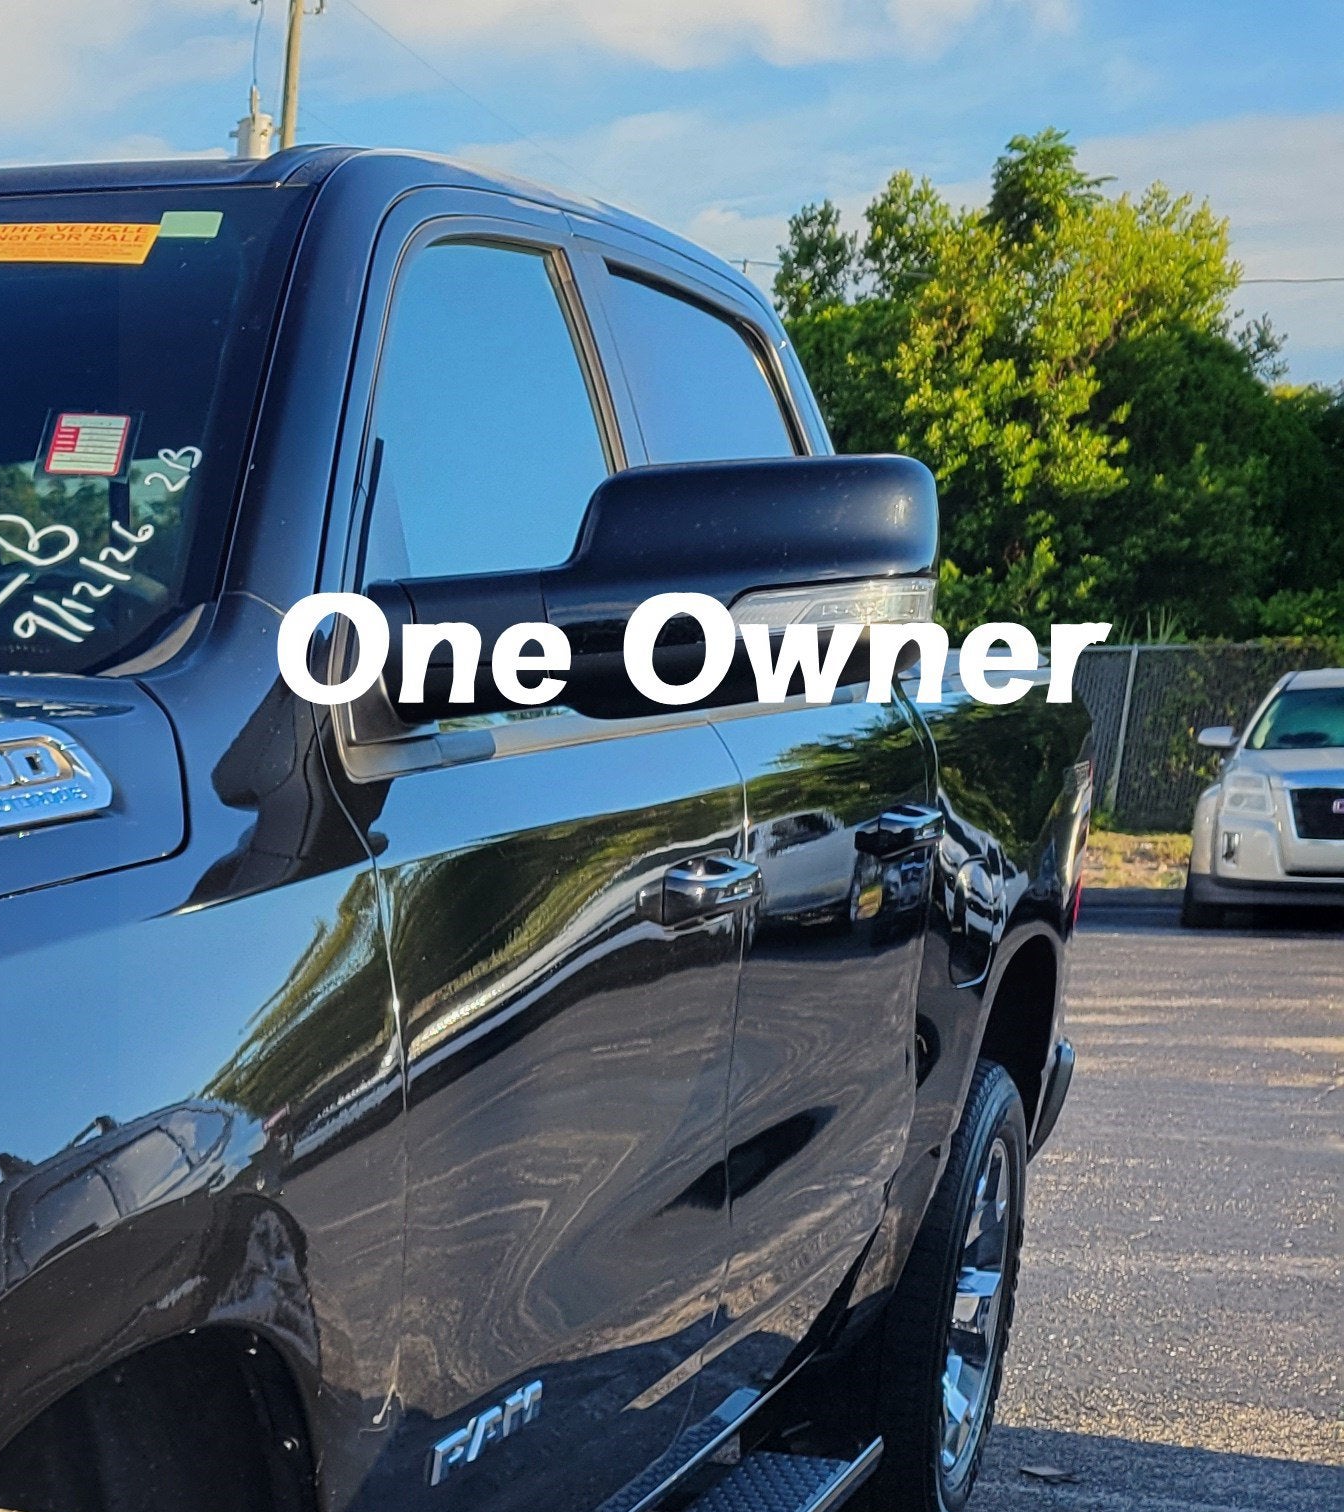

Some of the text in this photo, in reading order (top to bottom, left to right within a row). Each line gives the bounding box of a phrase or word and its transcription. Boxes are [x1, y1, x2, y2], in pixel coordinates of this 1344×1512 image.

[0, 225, 149, 233] THIS VEHICLE
[34, 233, 82, 242] FOR
[88, 233, 148, 242] SALE
